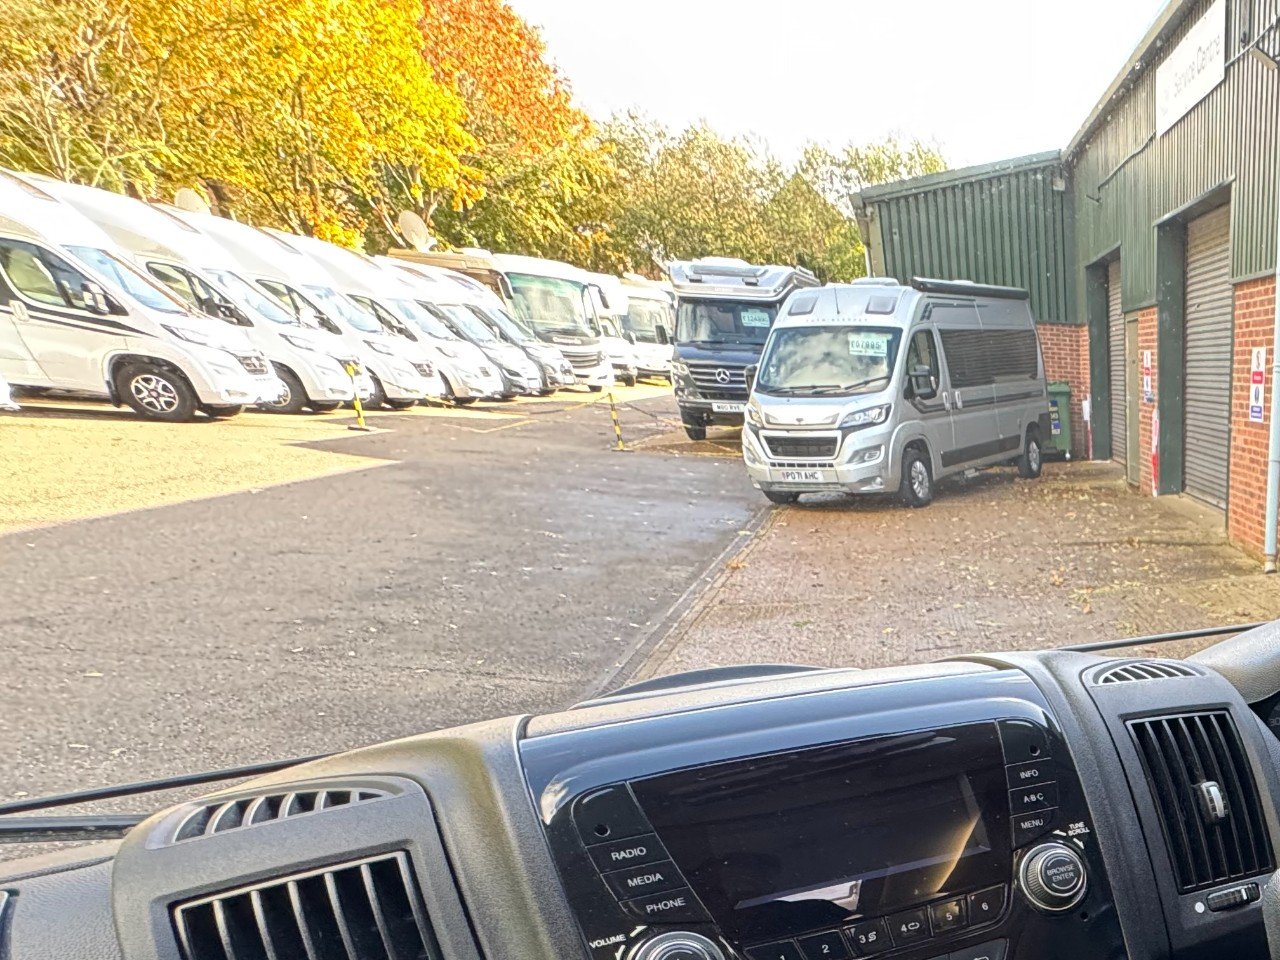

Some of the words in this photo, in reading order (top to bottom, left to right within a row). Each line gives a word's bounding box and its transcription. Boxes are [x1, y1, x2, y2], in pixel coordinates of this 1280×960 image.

[1269, 717, 1280, 726] 30
[1020, 769, 1039, 779] INFO
[1021, 819, 1044, 829] MENU
[1069, 821, 1085, 829] TUNE
[1068, 827, 1090, 836] SCROLL
[611, 846, 647, 861] RADIO
[1047, 864, 1074, 876] BROWSE
[627, 873, 664, 887] MEDIA
[1052, 872, 1074, 882] ENTER
[646, 897, 686, 913] PHONE
[982, 902, 988, 910] 6
[946, 912, 953, 920] 5
[901, 924, 907, 932] 4
[589, 934, 627, 948] VOLUME
[859, 935, 866, 943] 3
[821, 944, 830, 953] 2
